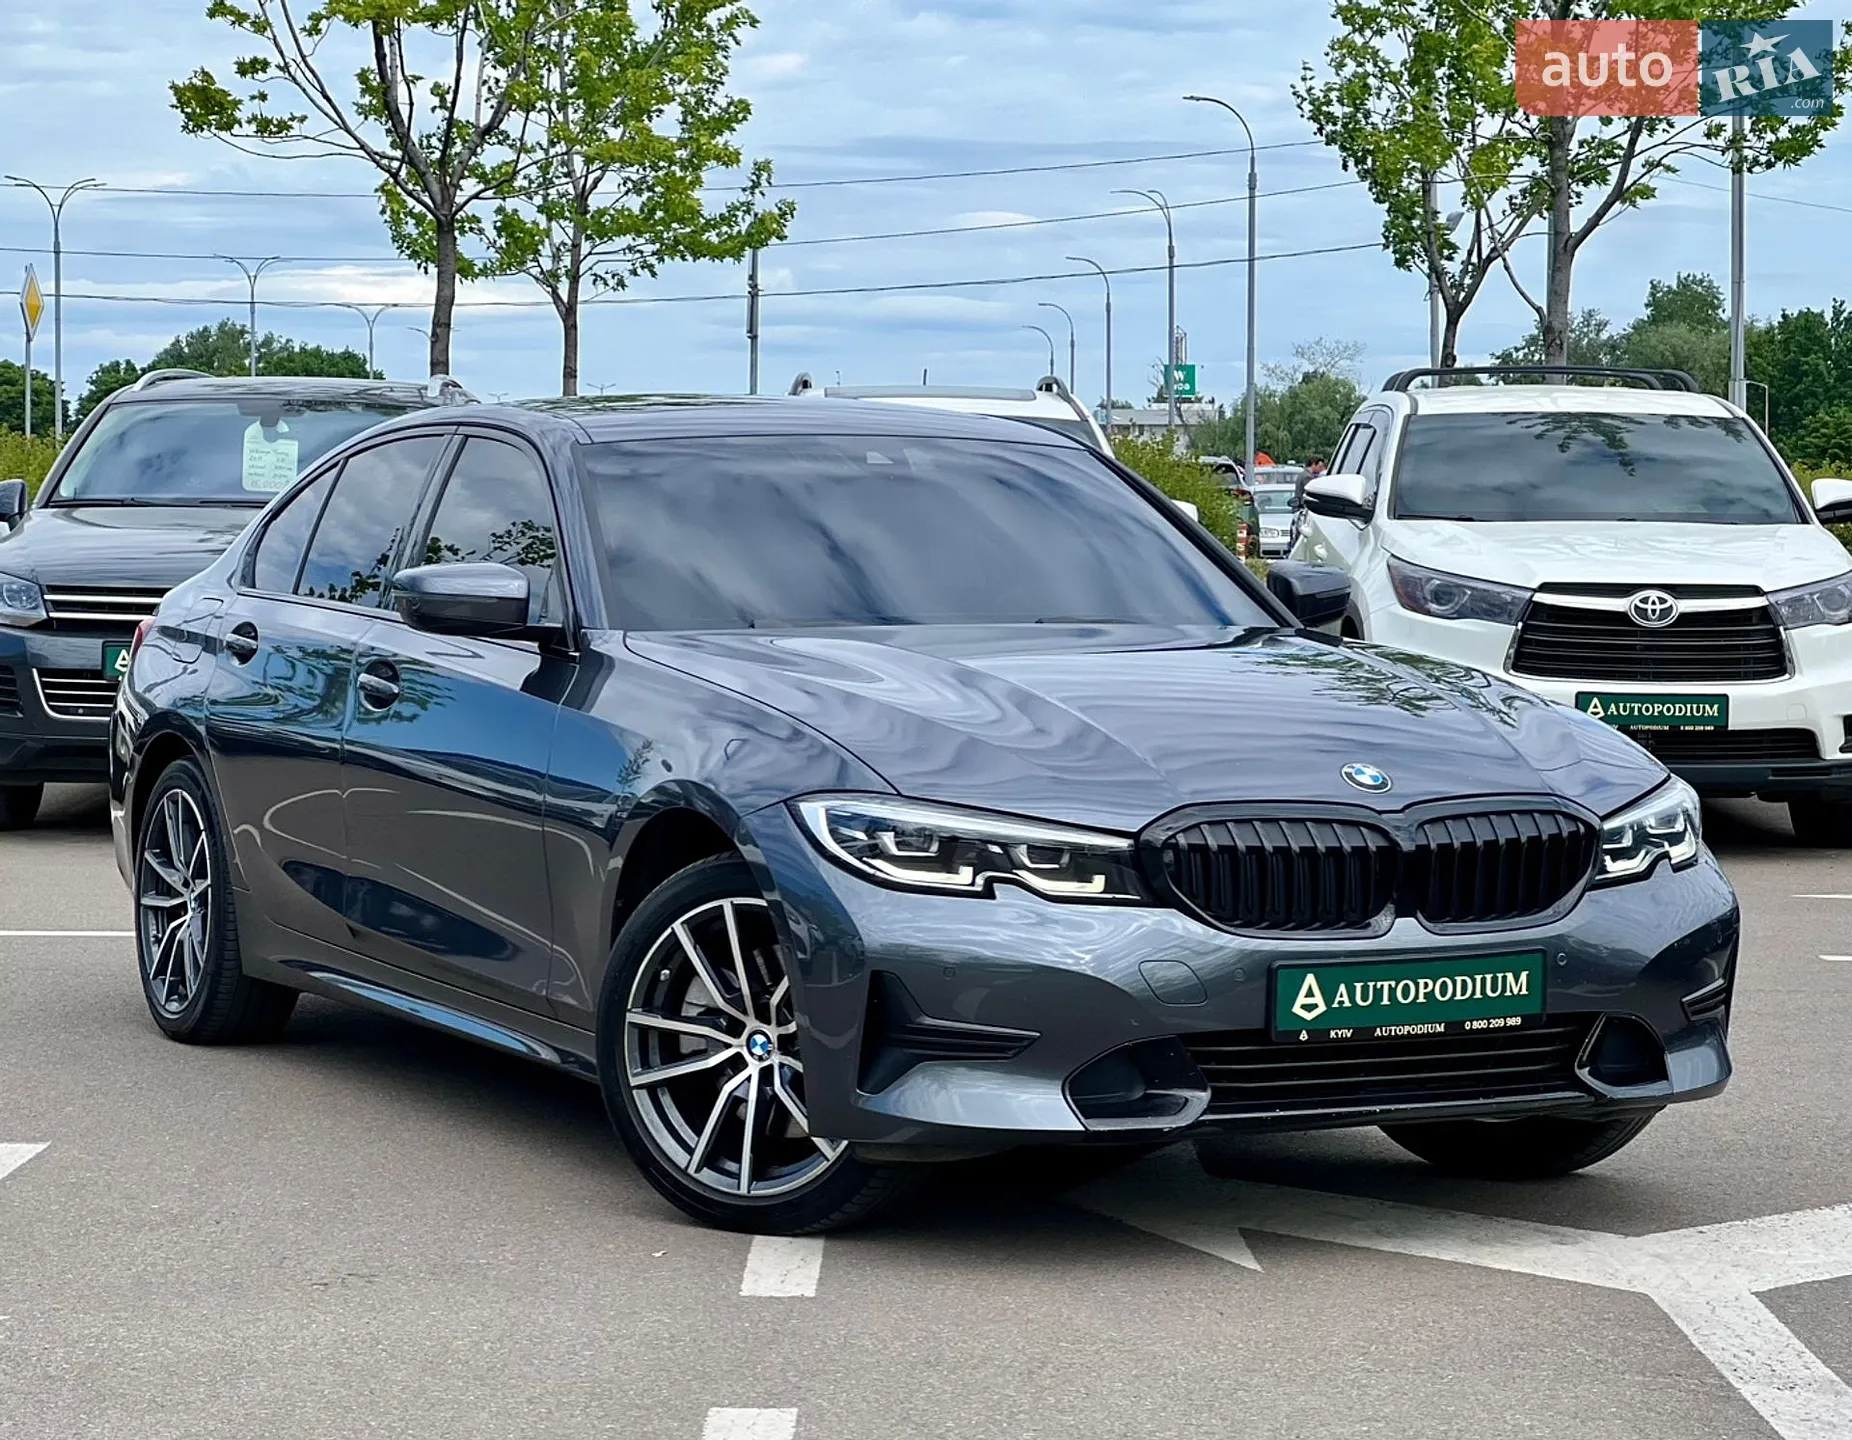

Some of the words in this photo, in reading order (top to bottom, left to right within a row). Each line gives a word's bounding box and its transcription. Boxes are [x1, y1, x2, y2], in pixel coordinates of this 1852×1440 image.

[1607, 703, 1720, 717] AUTOPODIUM
[1331, 970, 1530, 1008] AUTOPODIUM
[1329, 1028, 1354, 1039] KYIV
[1374, 1022, 1446, 1037] AUTOPODIUM
[1471, 1019, 1488, 1030] 800
[1489, 1017, 1505, 1028] 209
